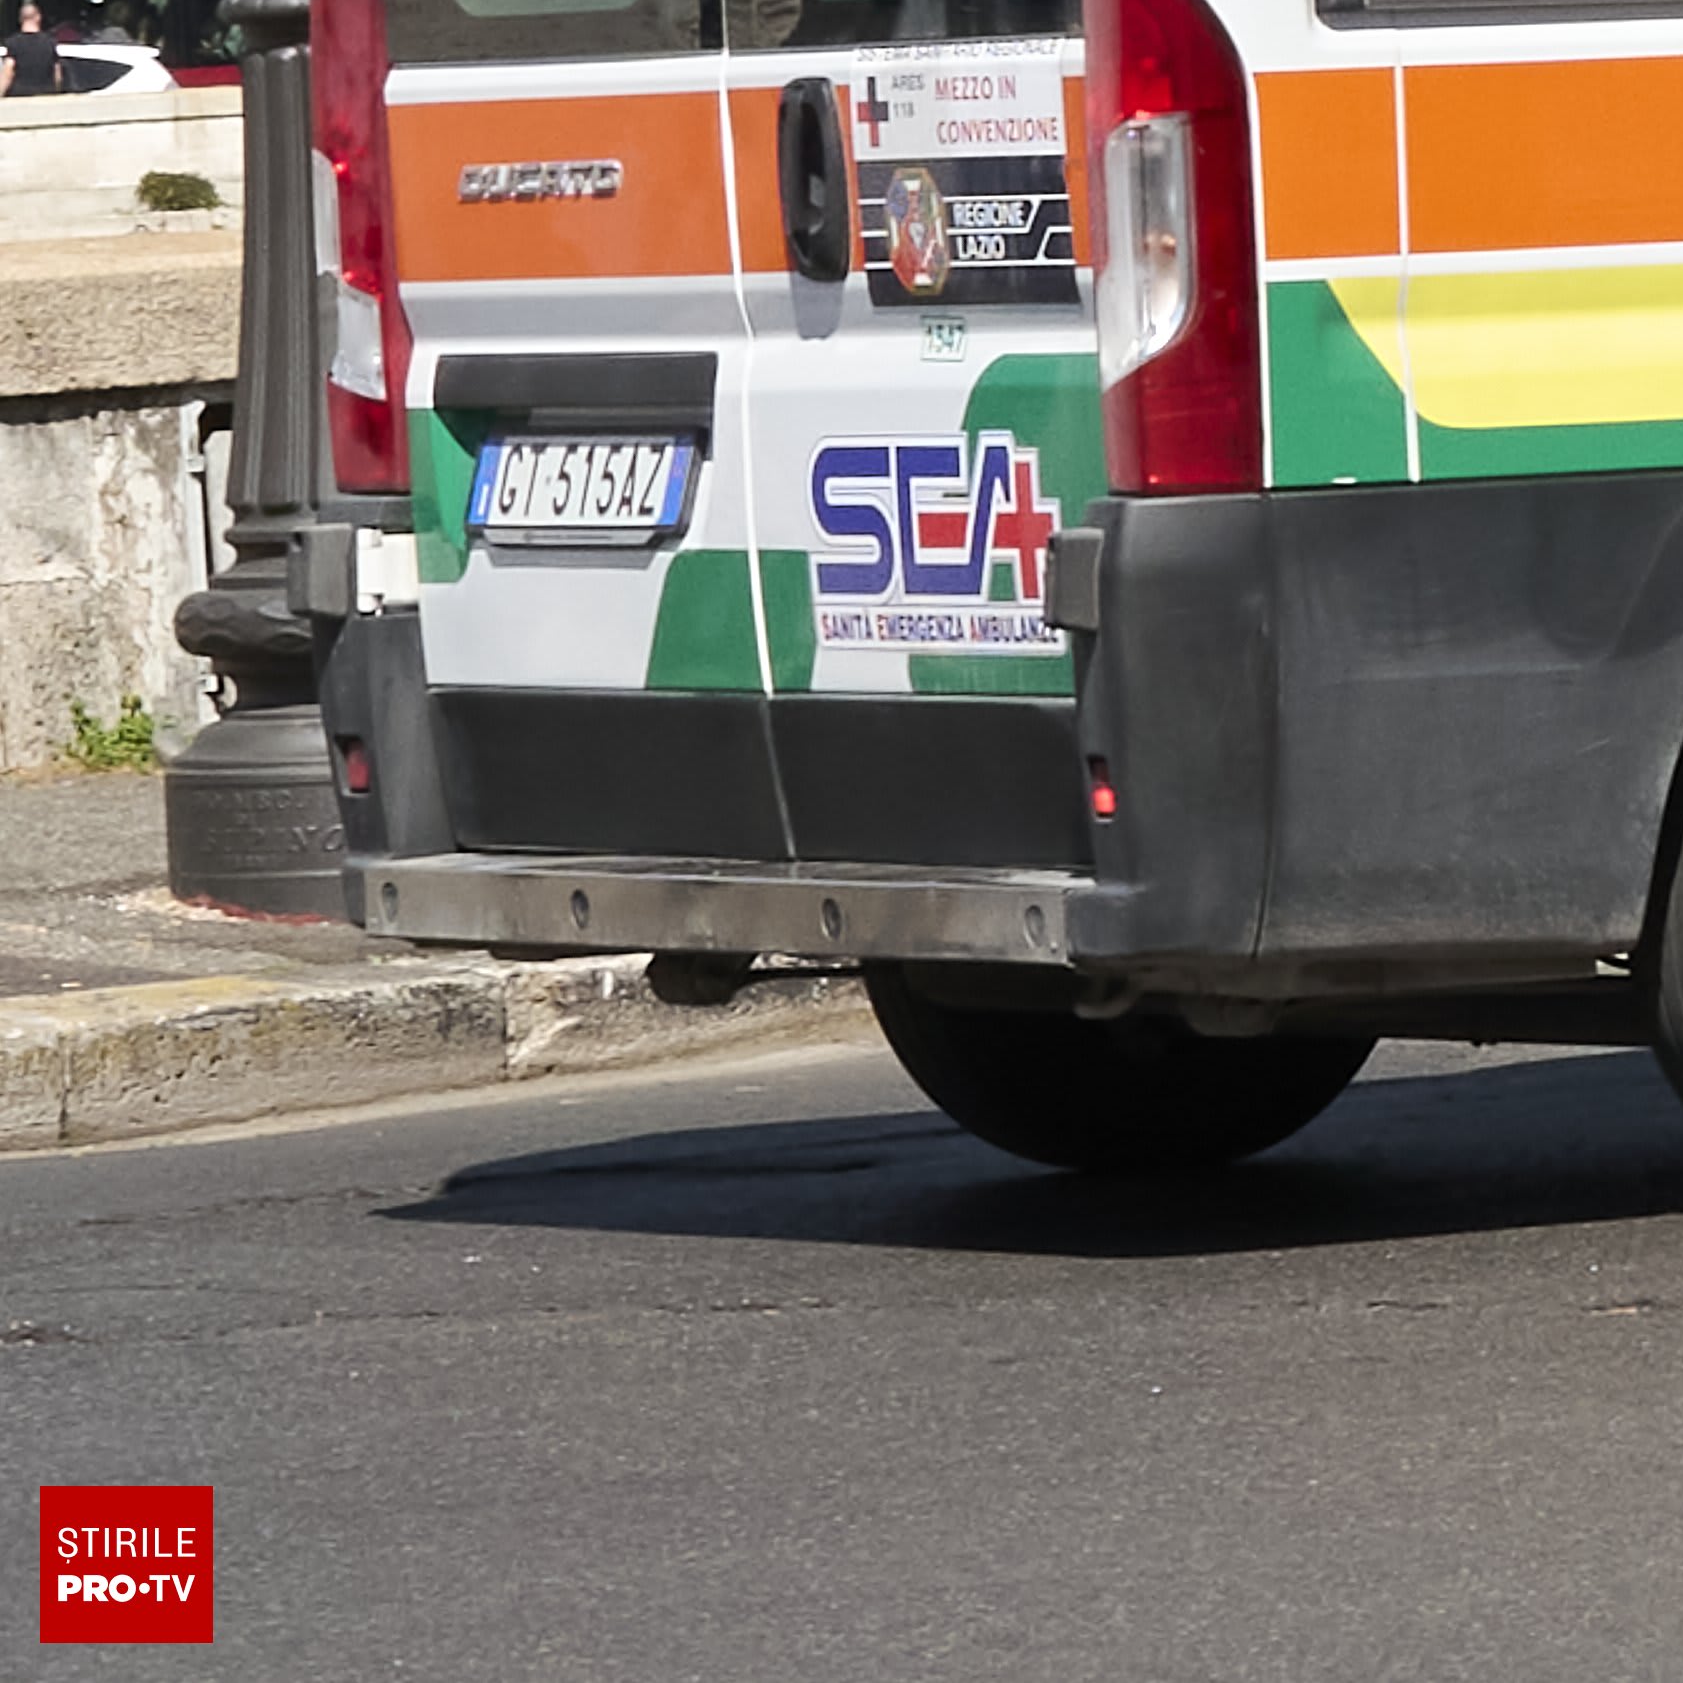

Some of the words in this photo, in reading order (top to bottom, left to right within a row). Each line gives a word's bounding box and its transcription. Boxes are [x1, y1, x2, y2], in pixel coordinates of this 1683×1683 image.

[934, 75, 993, 101] MEZZO
[998, 75, 1017, 99] IN
[936, 117, 1059, 144] CONVENZIONE
[952, 202, 1025, 227] REGIONE
[956, 234, 1006, 260] LAZIO
